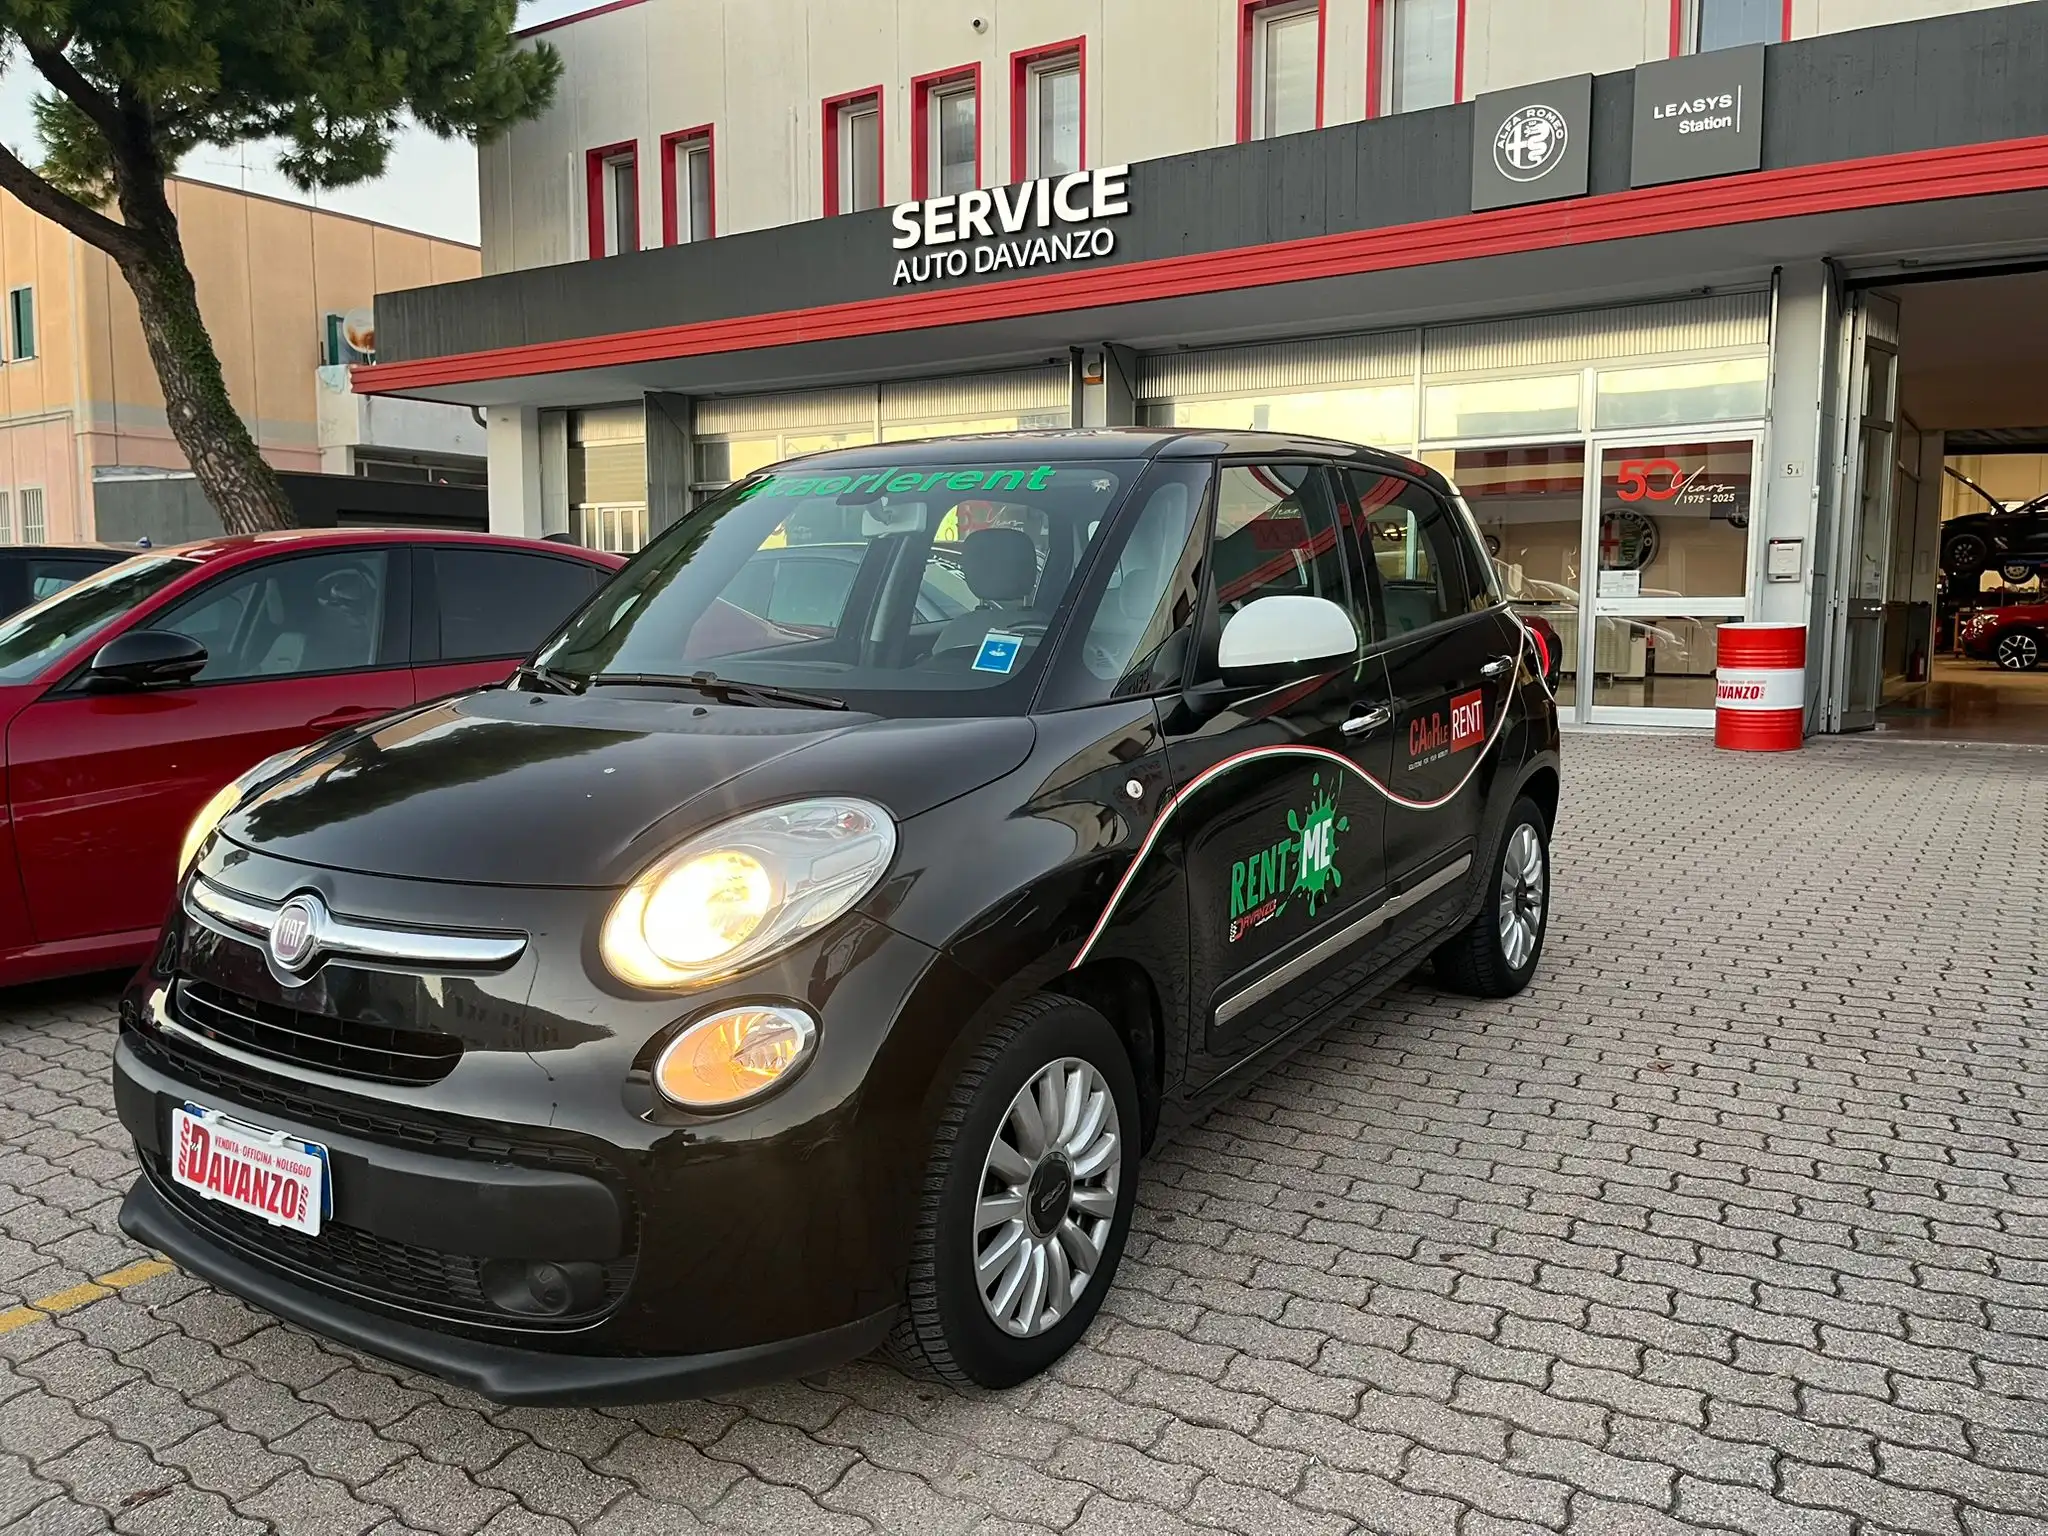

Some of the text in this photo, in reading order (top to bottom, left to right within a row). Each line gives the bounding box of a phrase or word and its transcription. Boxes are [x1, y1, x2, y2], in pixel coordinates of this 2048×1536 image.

[1653, 94, 1733, 119] LEASYS
[1678, 116, 1732, 134] Station
[1497, 109, 1564, 149] ALFA ROMEO
[891, 163, 1129, 250] SERVICE
[892, 227, 1114, 286] AUTO DAVANZO
[1616, 459, 1735, 505] 50 Years
[1787, 464, 1793, 475] 5
[1683, 495, 1704, 504] 1975
[1712, 494, 1735, 503] 2025
[1452, 700, 1482, 740] RENT
[1230, 818, 1332, 920] RENT ME
[279, 918, 306, 947] FIAT
[187, 1124, 299, 1219] DAVANZO
[215, 1136, 312, 1178] VENDITA OFFICINA NOLEGGIO
